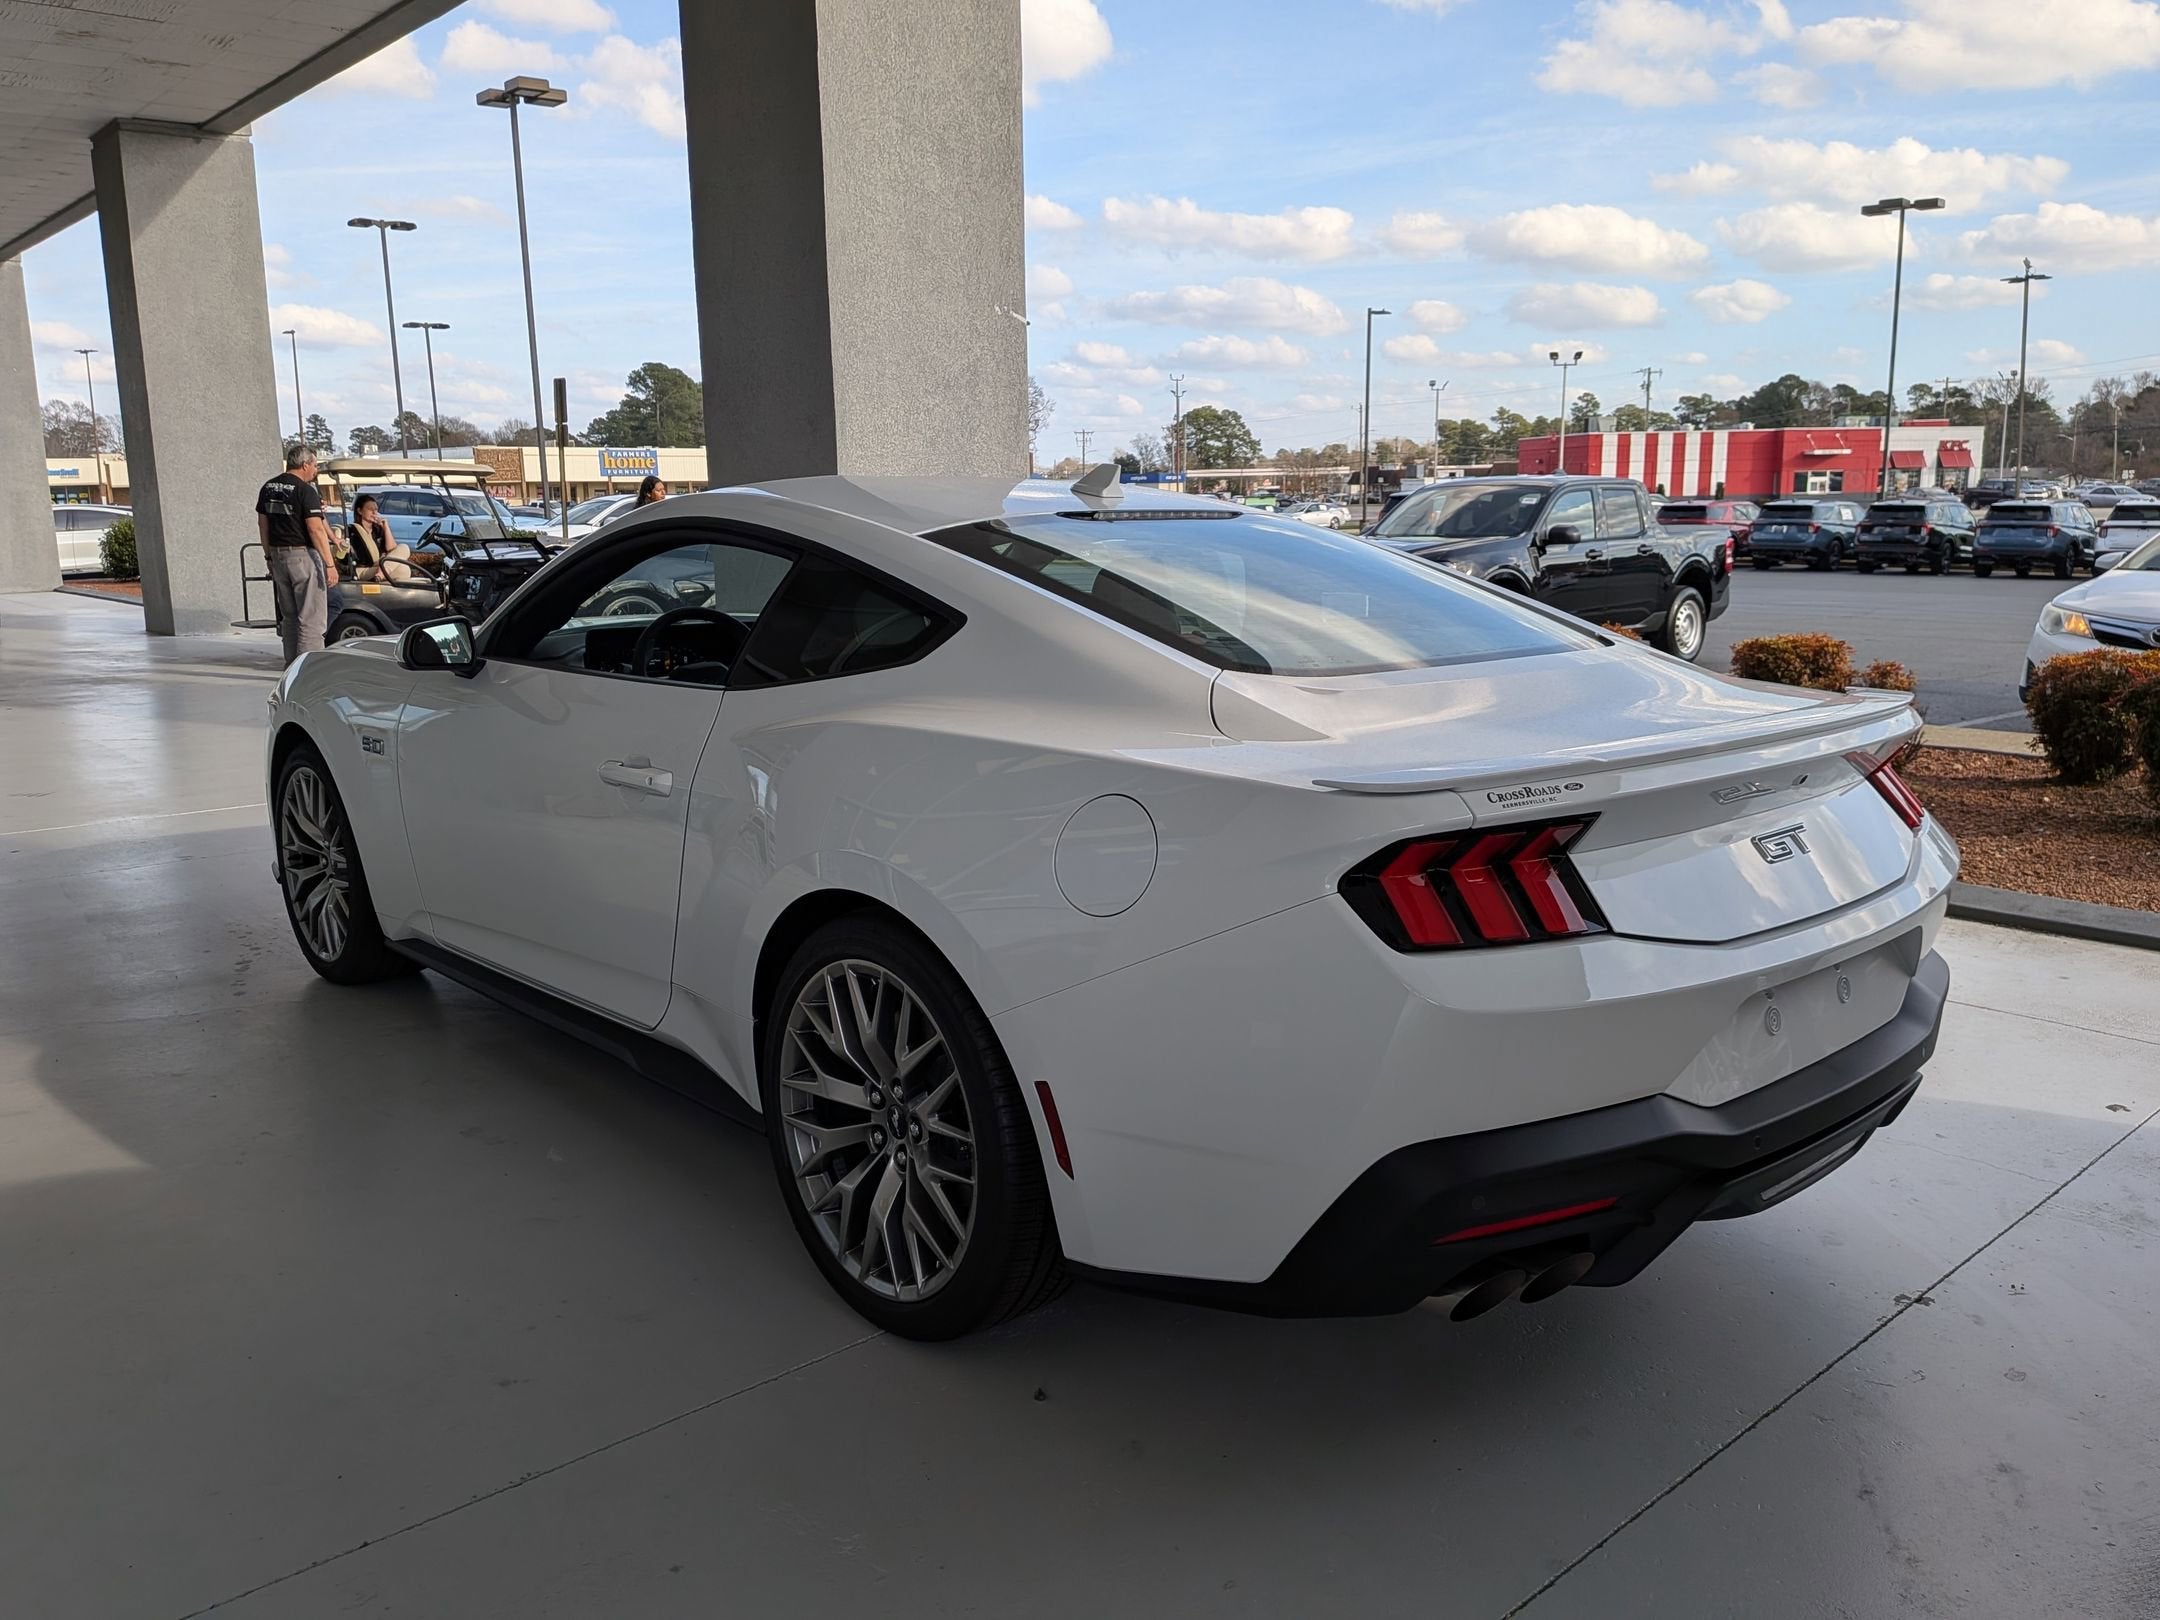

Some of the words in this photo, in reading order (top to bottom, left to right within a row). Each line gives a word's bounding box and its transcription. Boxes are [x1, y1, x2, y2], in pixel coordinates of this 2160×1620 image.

[1939, 440, 1970, 451] KFC
[603, 451, 656, 469] home
[1750, 822, 1811, 864] GT
